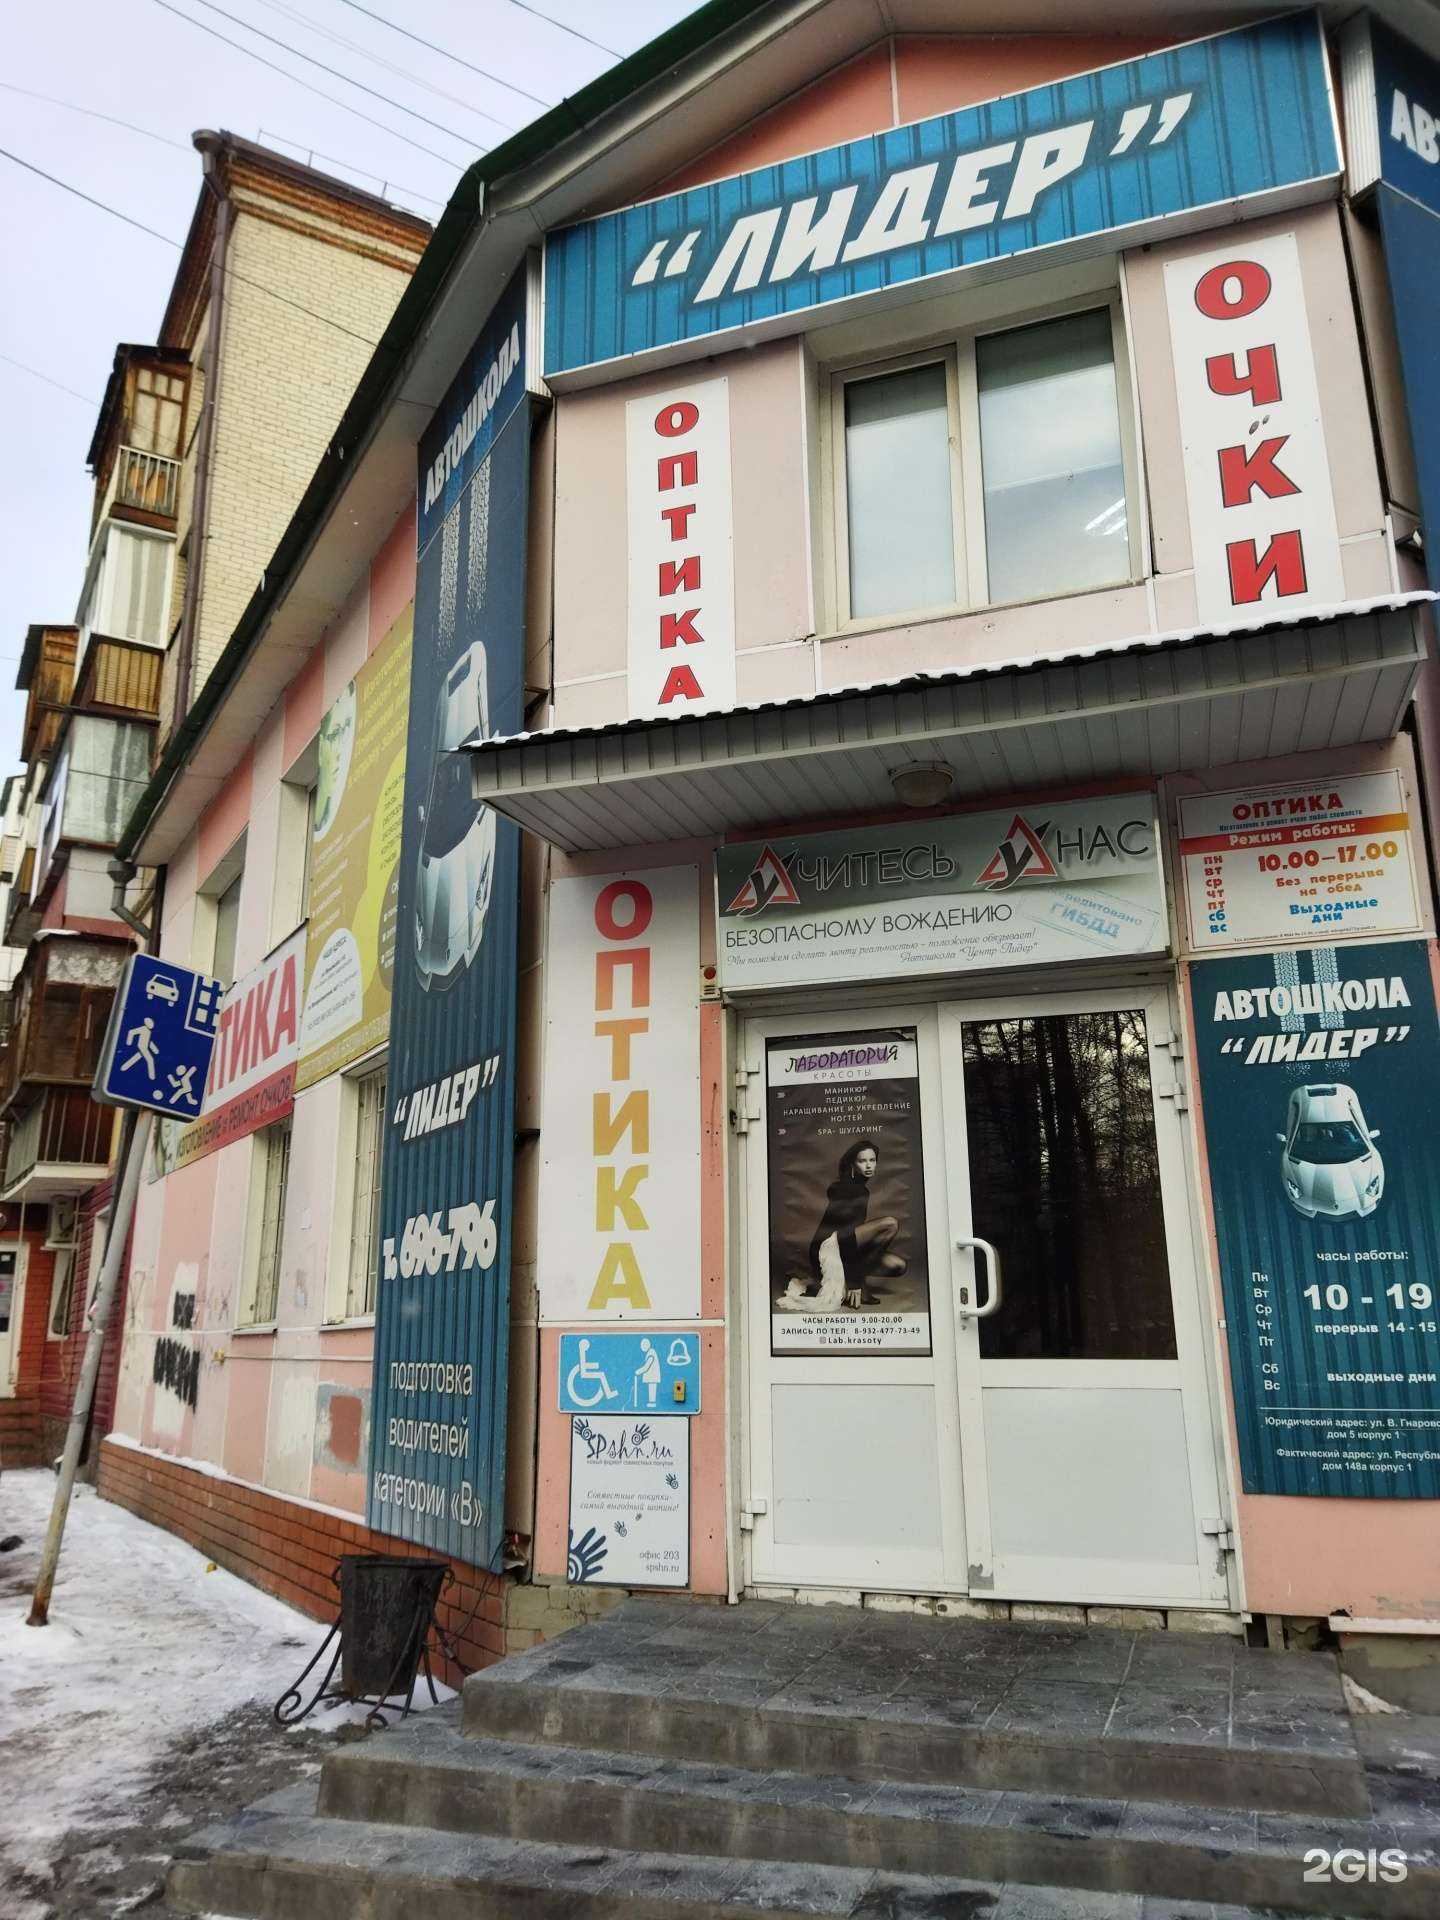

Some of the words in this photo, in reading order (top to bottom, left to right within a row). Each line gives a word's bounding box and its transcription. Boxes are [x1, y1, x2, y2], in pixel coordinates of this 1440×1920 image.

[1391, 88, 1440, 164] АВ
[424, 321, 520, 515] АВТОШКОЛА
[1194, 260, 1302, 605] ОЧКИ
[654, 401, 705, 705] ОПТИКА
[1233, 793, 1343, 820] ОПТИКА
[1229, 831, 1282, 846] Режим
[1292, 823, 1356, 841] работы:
[1057, 821, 1149, 865] НАС
[1276, 878, 1300, 887] Без
[1310, 868, 1384, 884] перерыва
[1300, 887, 1317, 896] на
[1328, 883, 1362, 895] обед
[1290, 898, 1378, 915] Выходные
[1049, 902, 1121, 939] ГИБДД
[1209, 908, 1226, 922] сб
[1312, 912, 1343, 924] дни
[726, 918, 875, 948] БЕЗОПАСНОМУ
[883, 904, 1012, 932] ВОЖДЕНИЮ
[1213, 976, 1411, 1022] АВТОШКОЛА
[785, 1045, 899, 1073] ЛАБОРАТОРИЯ
[814, 1069, 871, 1080] КРАСОТЫ
[587, 879, 652, 1309] ОПТИКА
[824, 1086, 867, 1095] МАНИКЮР
[826, 1095, 866, 1104] ПЕДИКЮР
[783, 1105, 845, 1116] НАРАЩИВАНИЕ
[857, 1102, 912, 1112] УКРЕПЛЕНИЕ
[831, 1113, 863, 1122] НОГТЕЙ
[840, 1126, 883, 1135] ШУГАРИНГ
[1317, 1252, 1350, 1261] часы
[1354, 1250, 1408, 1262] работы:
[1252, 1272, 1268, 1282] Пн
[1254, 1288, 1269, 1298] Вт
[1303, 1284, 1349, 1310] 10
[1386, 1283, 1432, 1310] 19
[1255, 1304, 1272, 1315] Ср
[861, 1316, 903, 1324] 9.00-20.00
[1257, 1320, 1272, 1330] Чт
[854, 1327, 920, 1335] 8-932-477-73-49
[1315, 1324, 1378, 1334] перерыв
[1387, 1323, 1405, 1333] 14
[1418, 1322, 1436, 1333] 15
[1259, 1336, 1274, 1346] Пт
[1262, 1363, 1279, 1373] Сб
[390, 1361, 473, 1397] подготовка
[1327, 1373, 1404, 1382] выходные
[1408, 1373, 1436, 1383] дни
[1264, 1380, 1280, 1390] Вс
[1265, 1416, 1333, 1428] Юридический
[1335, 1419, 1367, 1428] адрес:
[1370, 1420, 1385, 1428] ул.
[389, 1416, 469, 1459] водителей
[1327, 1431, 1347, 1439] дом
[1350, 1430, 1355, 1439] 5
[1357, 1431, 1392, 1441] корпус
[1394, 1430, 1400, 1439] 1
[1276, 1448, 1340, 1458] Фактический
[1342, 1450, 1375, 1460] адрес:
[1377, 1452, 1392, 1460] ул.
[1322, 1463, 1343, 1471] дом
[1345, 1462, 1367, 1471] 148а
[1369, 1464, 1404, 1473] корпус
[1407, 1463, 1412, 1471] 1
[374, 1471, 446, 1522] категории
[640, 1550, 661, 1562] офис
[663, 1550, 680, 1560] 203
[646, 1562, 680, 1573] spshn.ru
